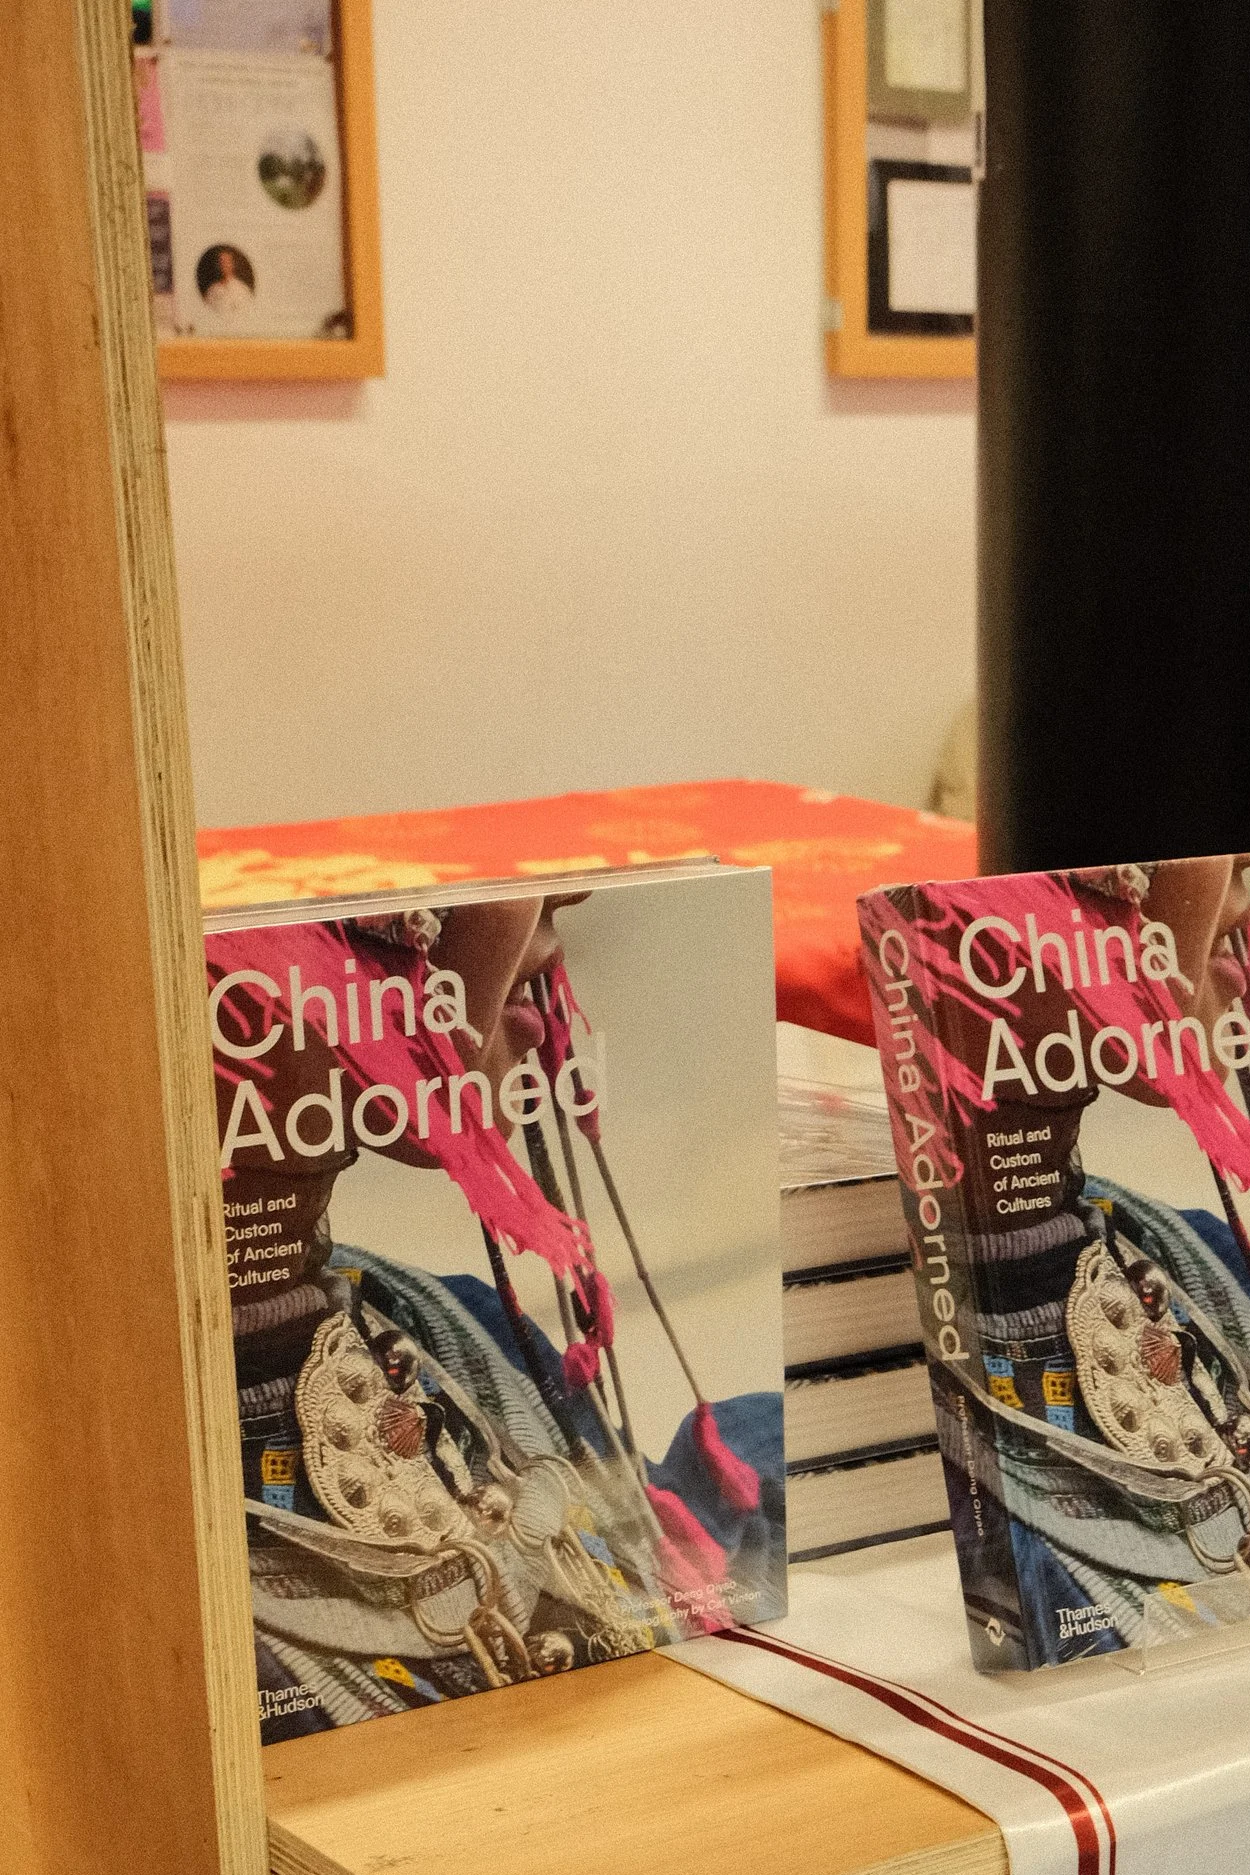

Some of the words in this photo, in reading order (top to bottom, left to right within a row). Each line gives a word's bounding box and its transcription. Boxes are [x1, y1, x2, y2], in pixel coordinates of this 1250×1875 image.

[959, 909, 1179, 999] China
[211, 959, 469, 1059] China
[220, 1031, 607, 1168] Adorned
[879, 928, 920, 1093] China
[905, 1113, 969, 1362] Adorned
[987, 1130, 1023, 1149] Ritual
[1026, 1126, 1051, 1146] and
[990, 1151, 1042, 1170] Custom
[994, 1175, 1008, 1192] of
[1010, 1170, 1060, 1189] Ancient
[222, 1199, 263, 1218] Ritual
[267, 1194, 296, 1213] and
[997, 1195, 1051, 1215] Cultures
[224, 1221, 282, 1242] Custom
[226, 1249, 240, 1266] of
[243, 1239, 302, 1262] Ancient
[227, 1267, 290, 1289] Cultures
[957, 1395, 972, 1457] Professor
[967, 1460, 978, 1495] Deng
[973, 1498, 985, 1538] Qiyao
[674, 1588, 704, 1603] Deng
[706, 1580, 737, 1595] Qiyao
[691, 1601, 704, 1615] by
[706, 1599, 725, 1611] Cat
[729, 1590, 761, 1605] Vinton
[1055, 1604, 1111, 1624] Thames
[1059, 1616, 1118, 1639] &Hudson
[258, 1684, 316, 1705] Thames
[258, 1695, 324, 1721] &Hudson
